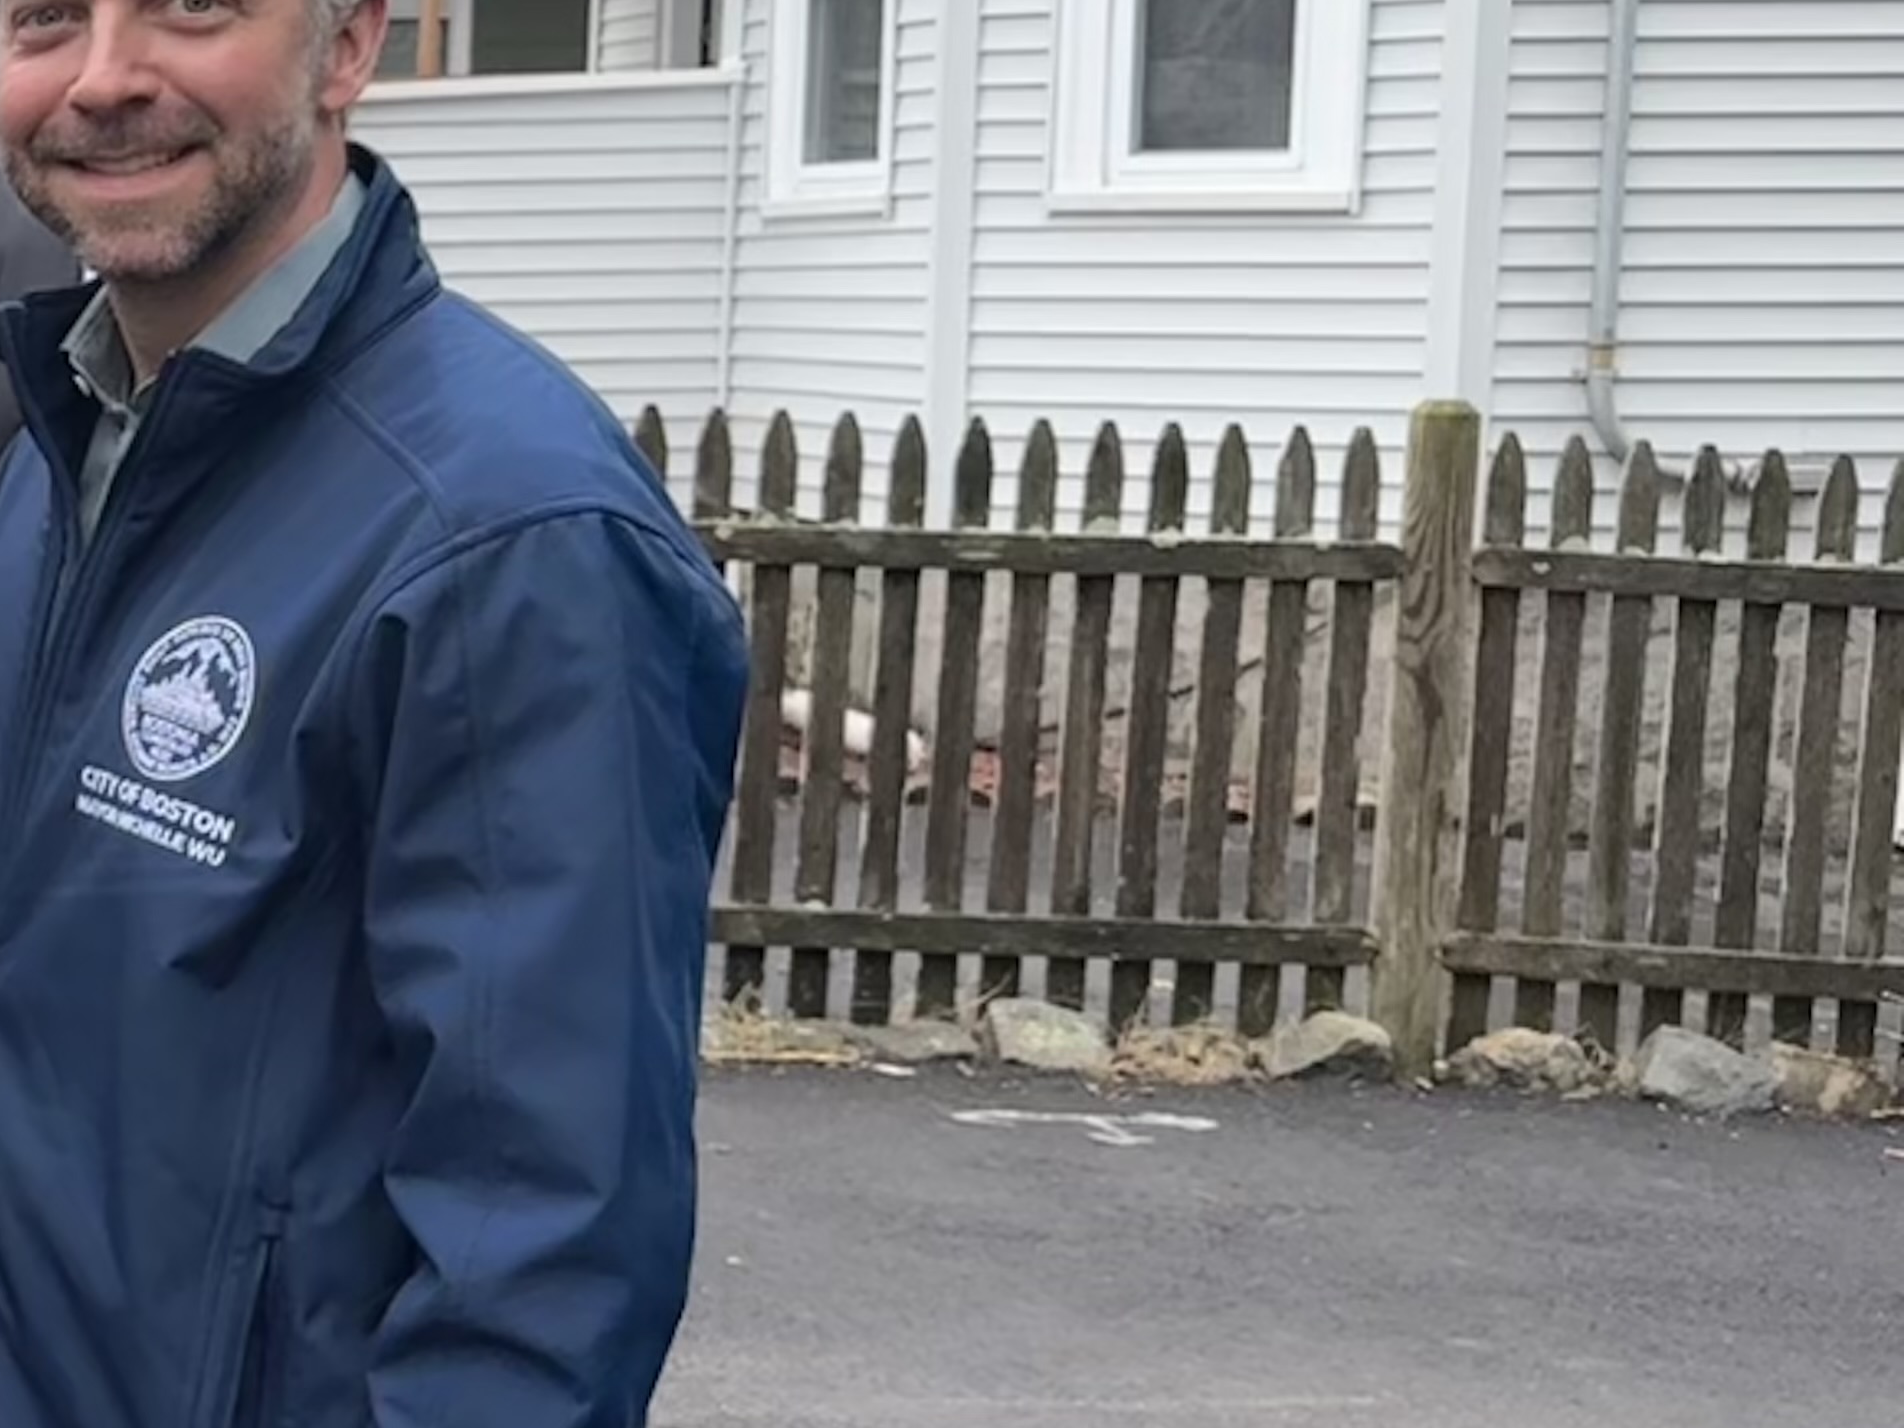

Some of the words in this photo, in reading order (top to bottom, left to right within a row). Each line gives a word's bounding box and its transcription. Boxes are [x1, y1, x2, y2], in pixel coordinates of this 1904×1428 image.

[80, 765, 118, 797] CITY
[117, 778, 143, 804] OF
[140, 787, 235, 843] BOSTON
[186, 836, 226, 867] WU
